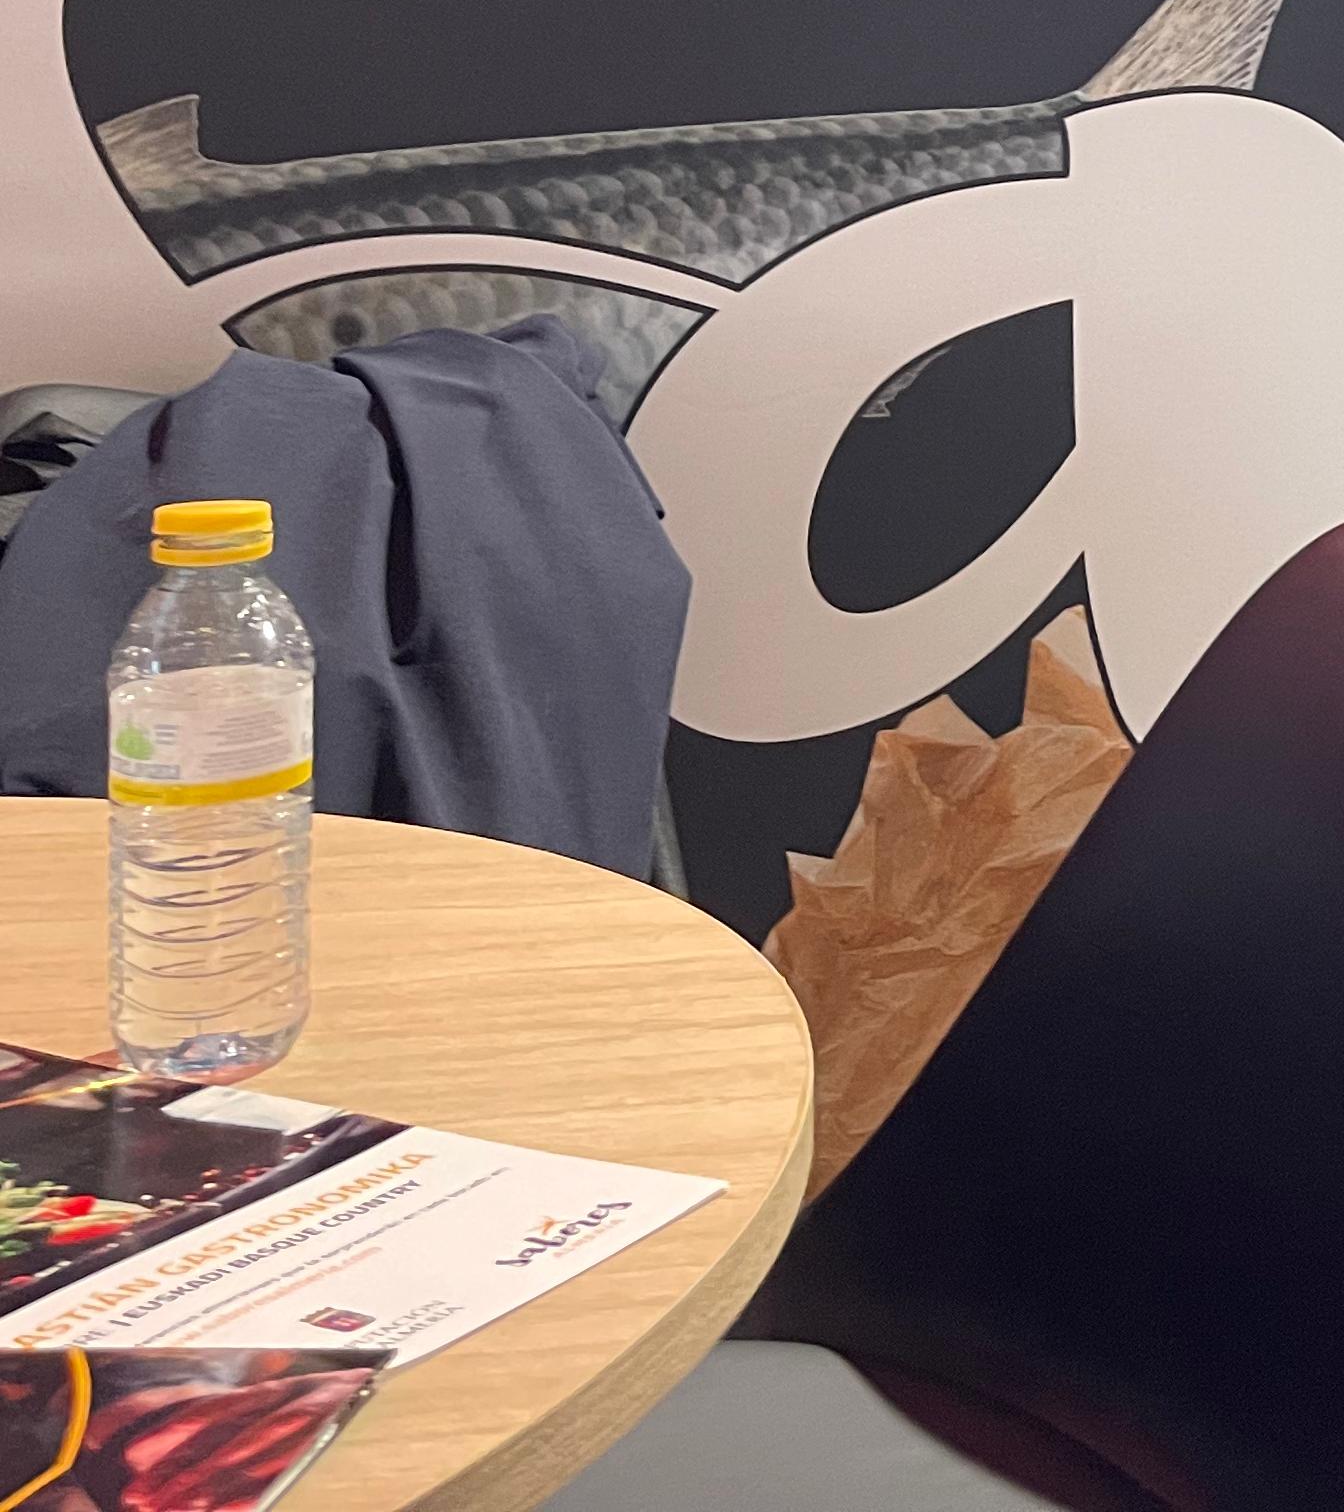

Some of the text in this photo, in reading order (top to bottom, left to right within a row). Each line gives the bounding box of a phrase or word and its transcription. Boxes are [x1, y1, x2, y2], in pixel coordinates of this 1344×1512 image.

[12, 1152, 434, 1349] ASTIÁN GASTRONOMIKA
[121, 1268, 233, 1319] EUSKADI
[226, 1227, 323, 1269] BASQUE
[318, 1179, 422, 1228] COUNTRY
